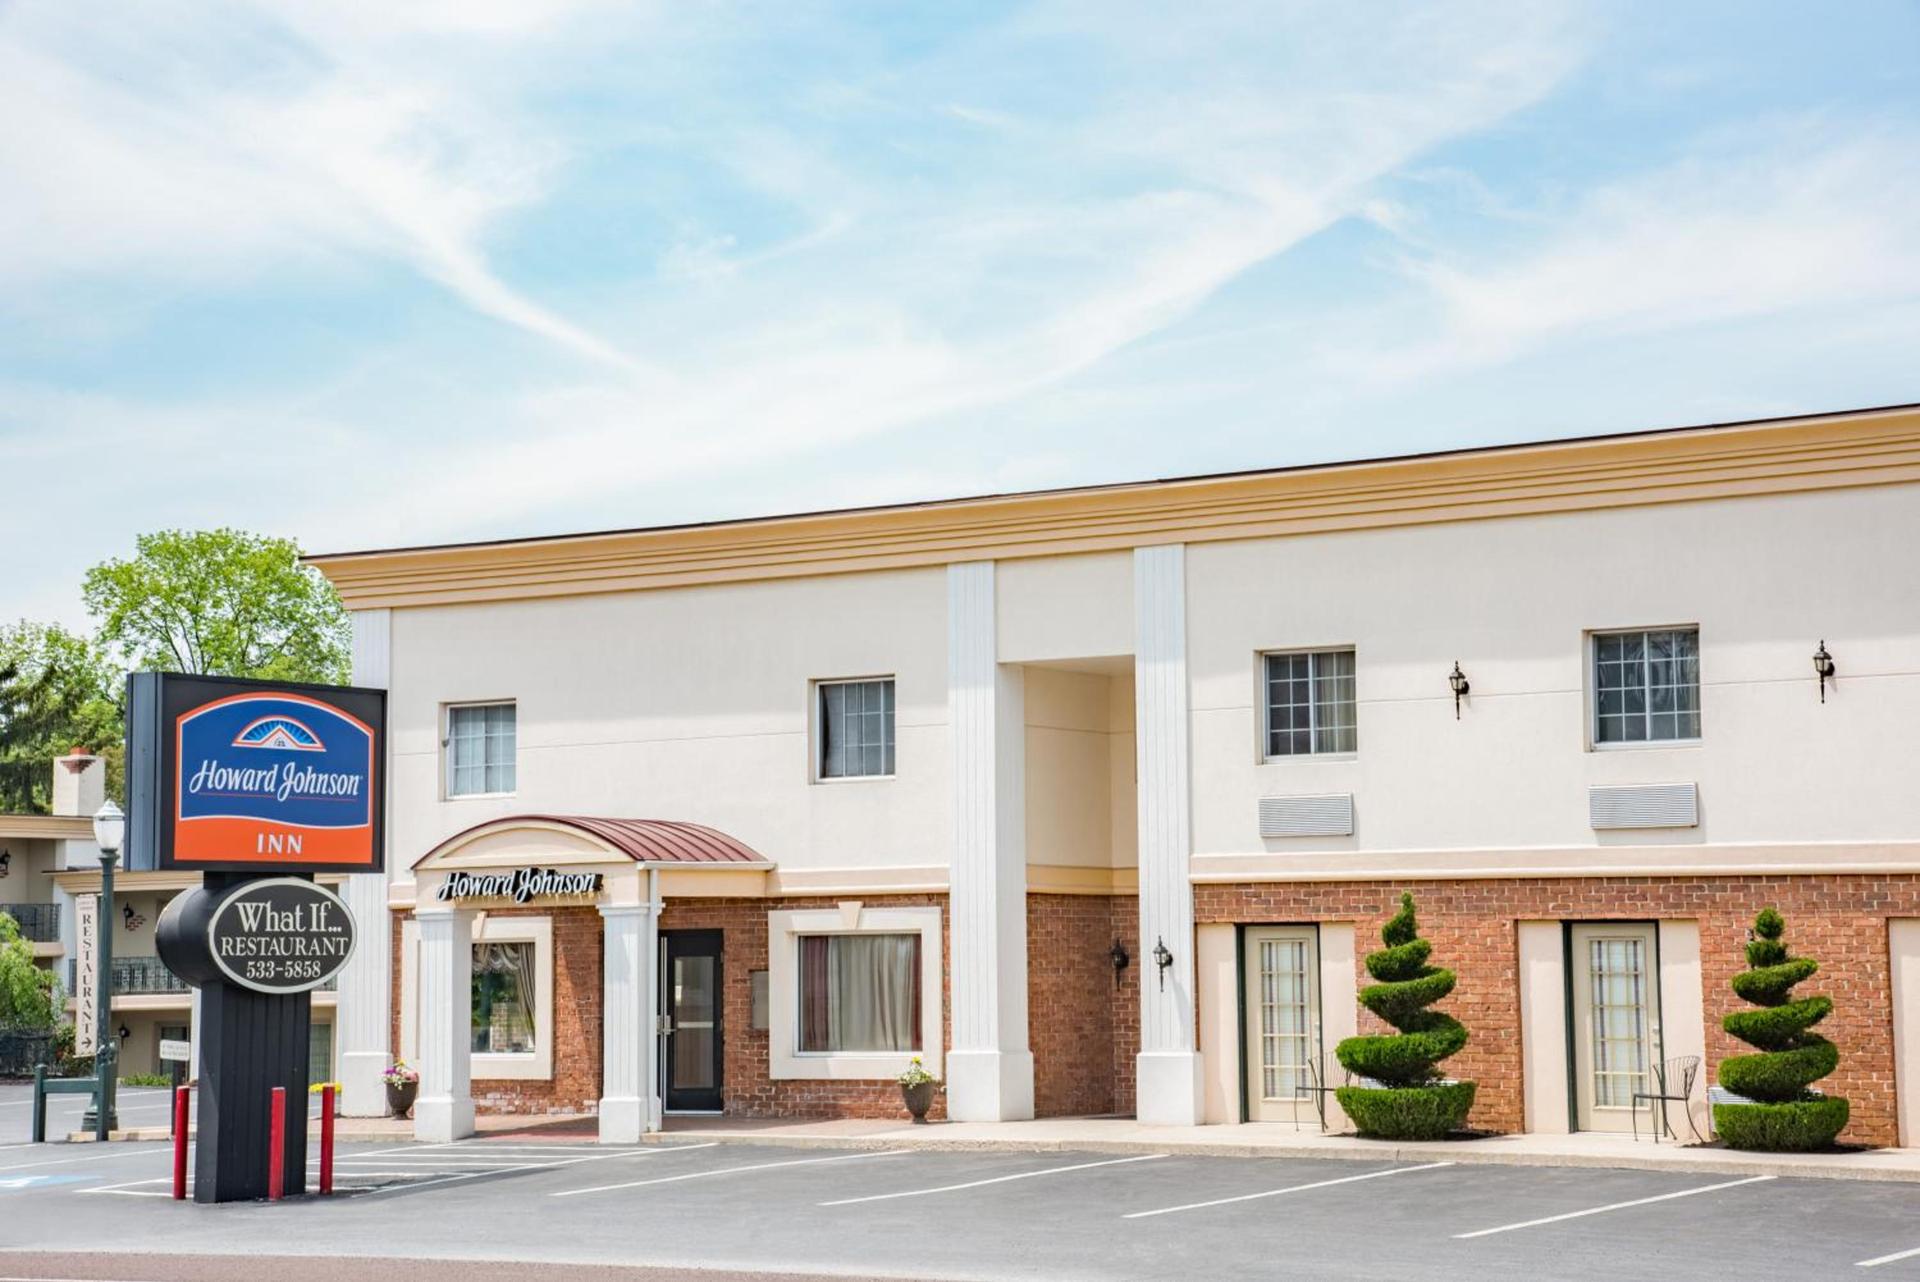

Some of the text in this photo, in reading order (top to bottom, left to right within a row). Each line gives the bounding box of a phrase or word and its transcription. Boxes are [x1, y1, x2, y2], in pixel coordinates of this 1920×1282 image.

[189, 760, 361, 801] Howard Johnson
[257, 834, 303, 854] INN
[437, 868, 598, 903] Howard Johnson
[236, 901, 342, 933] What If...
[221, 936, 348, 957] RESTAURANT
[82, 913, 94, 1034] RESTAURANT
[246, 961, 321, 980] 533-5858
